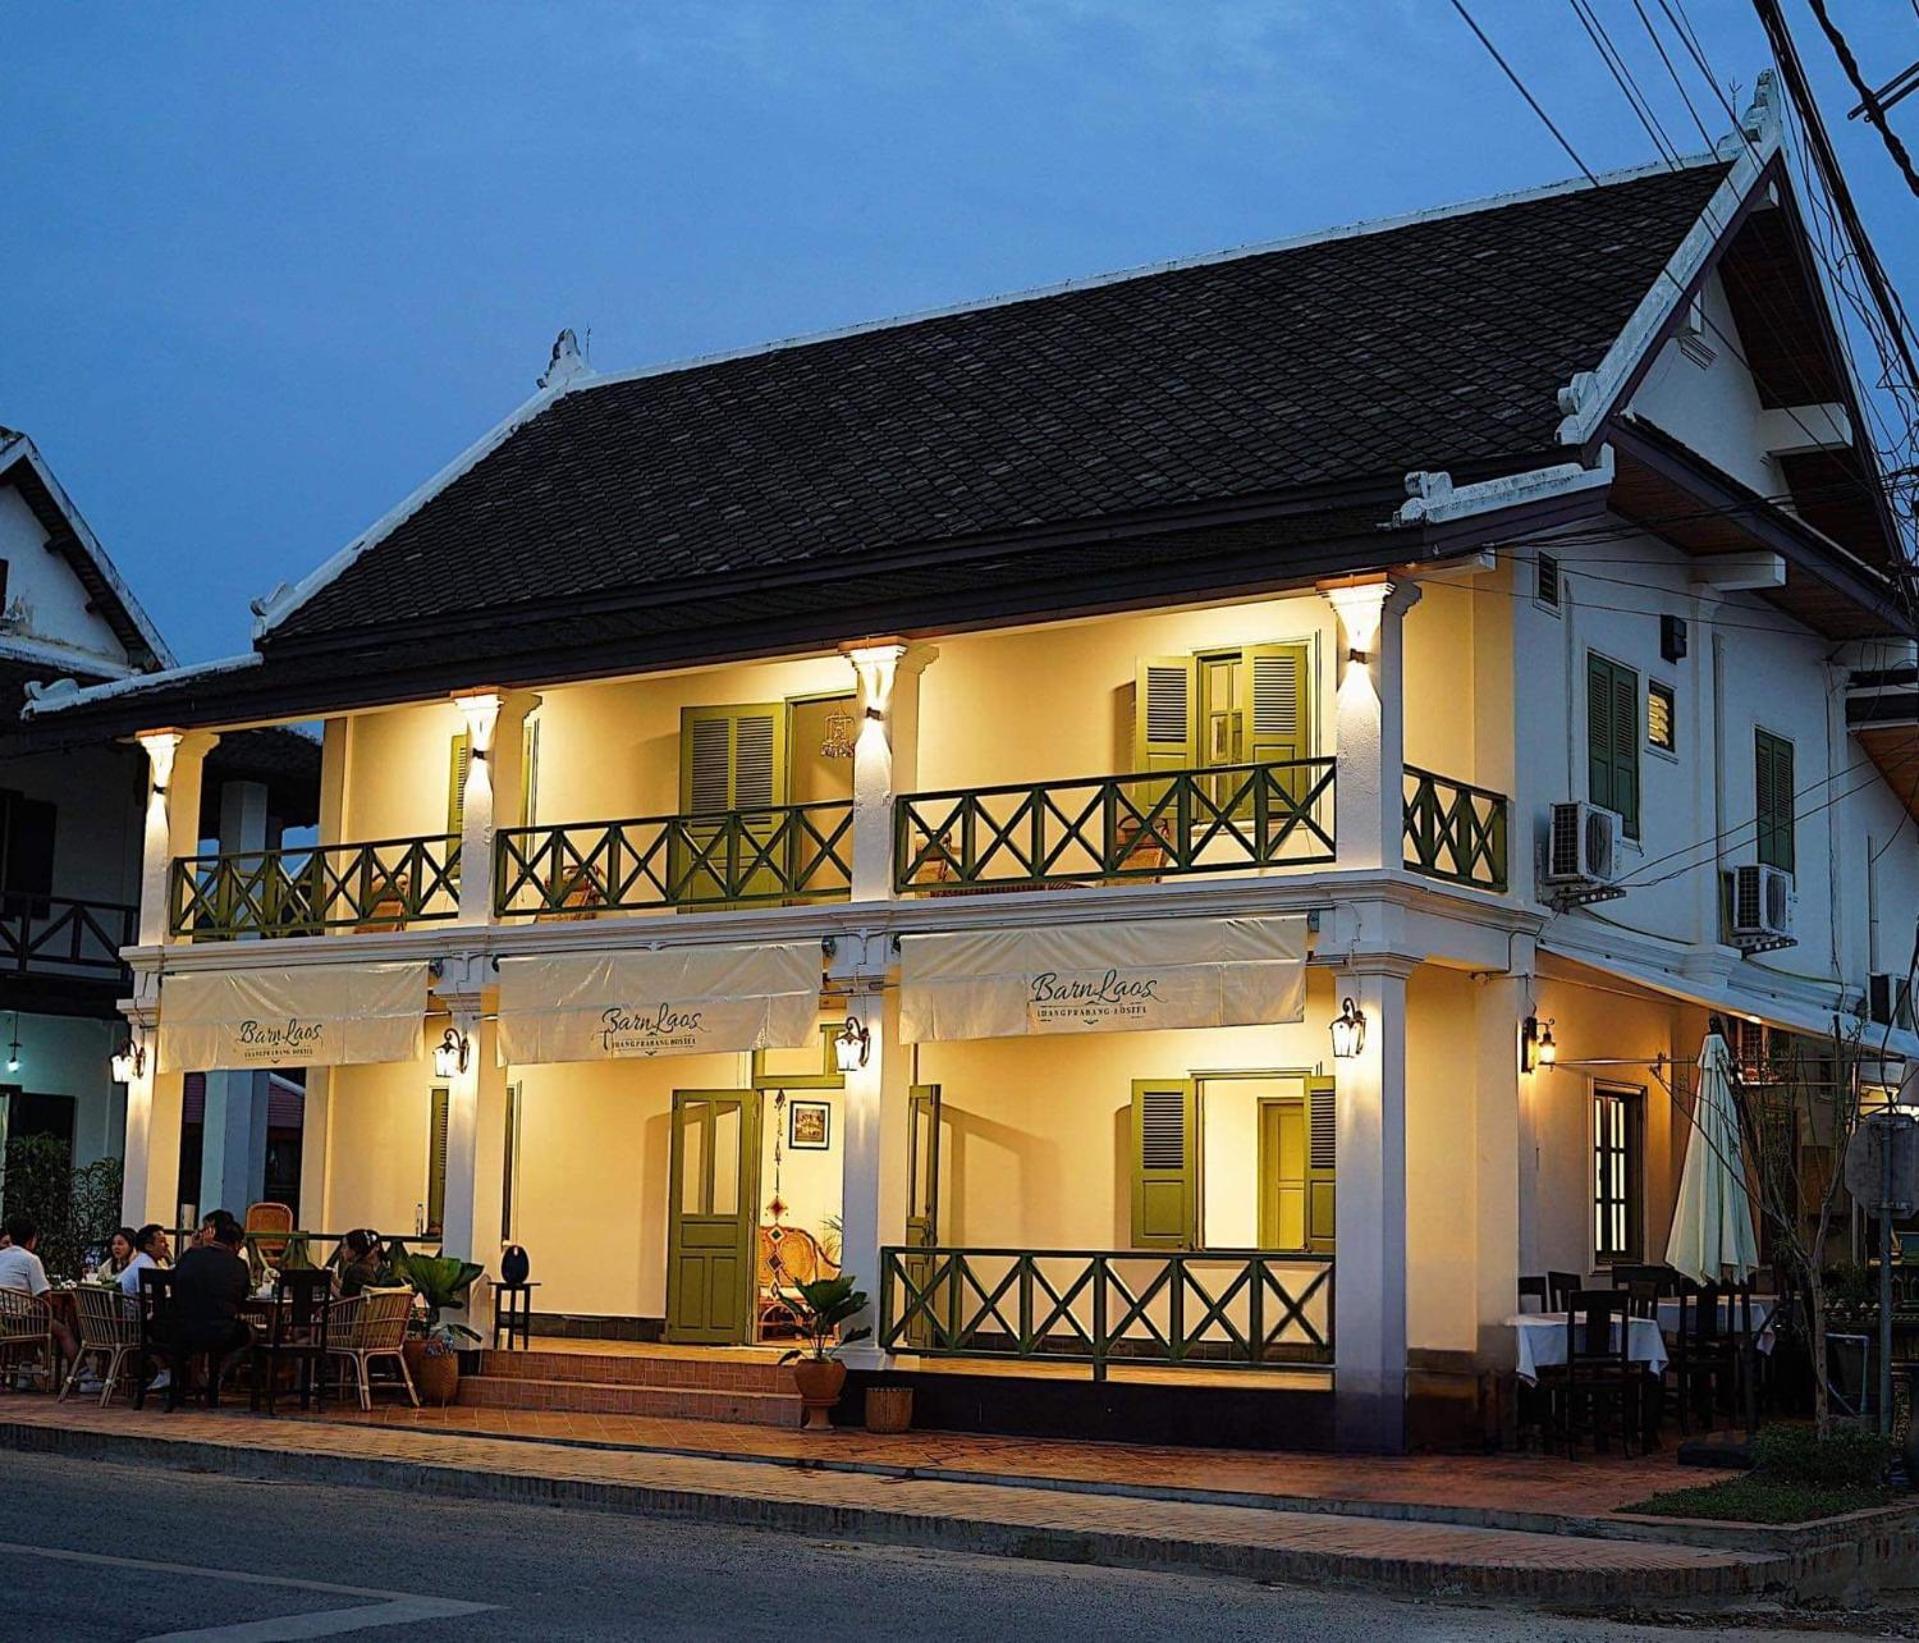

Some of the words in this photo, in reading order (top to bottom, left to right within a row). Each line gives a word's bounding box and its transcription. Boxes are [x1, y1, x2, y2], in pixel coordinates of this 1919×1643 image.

[1028, 972, 1098, 1003] Barn
[1097, 968, 1164, 1003] Laos
[239, 1020, 282, 1044] Barn
[282, 1018, 323, 1047] Laos
[598, 1008, 655, 1043] Barn
[655, 1002, 709, 1034] Laos
